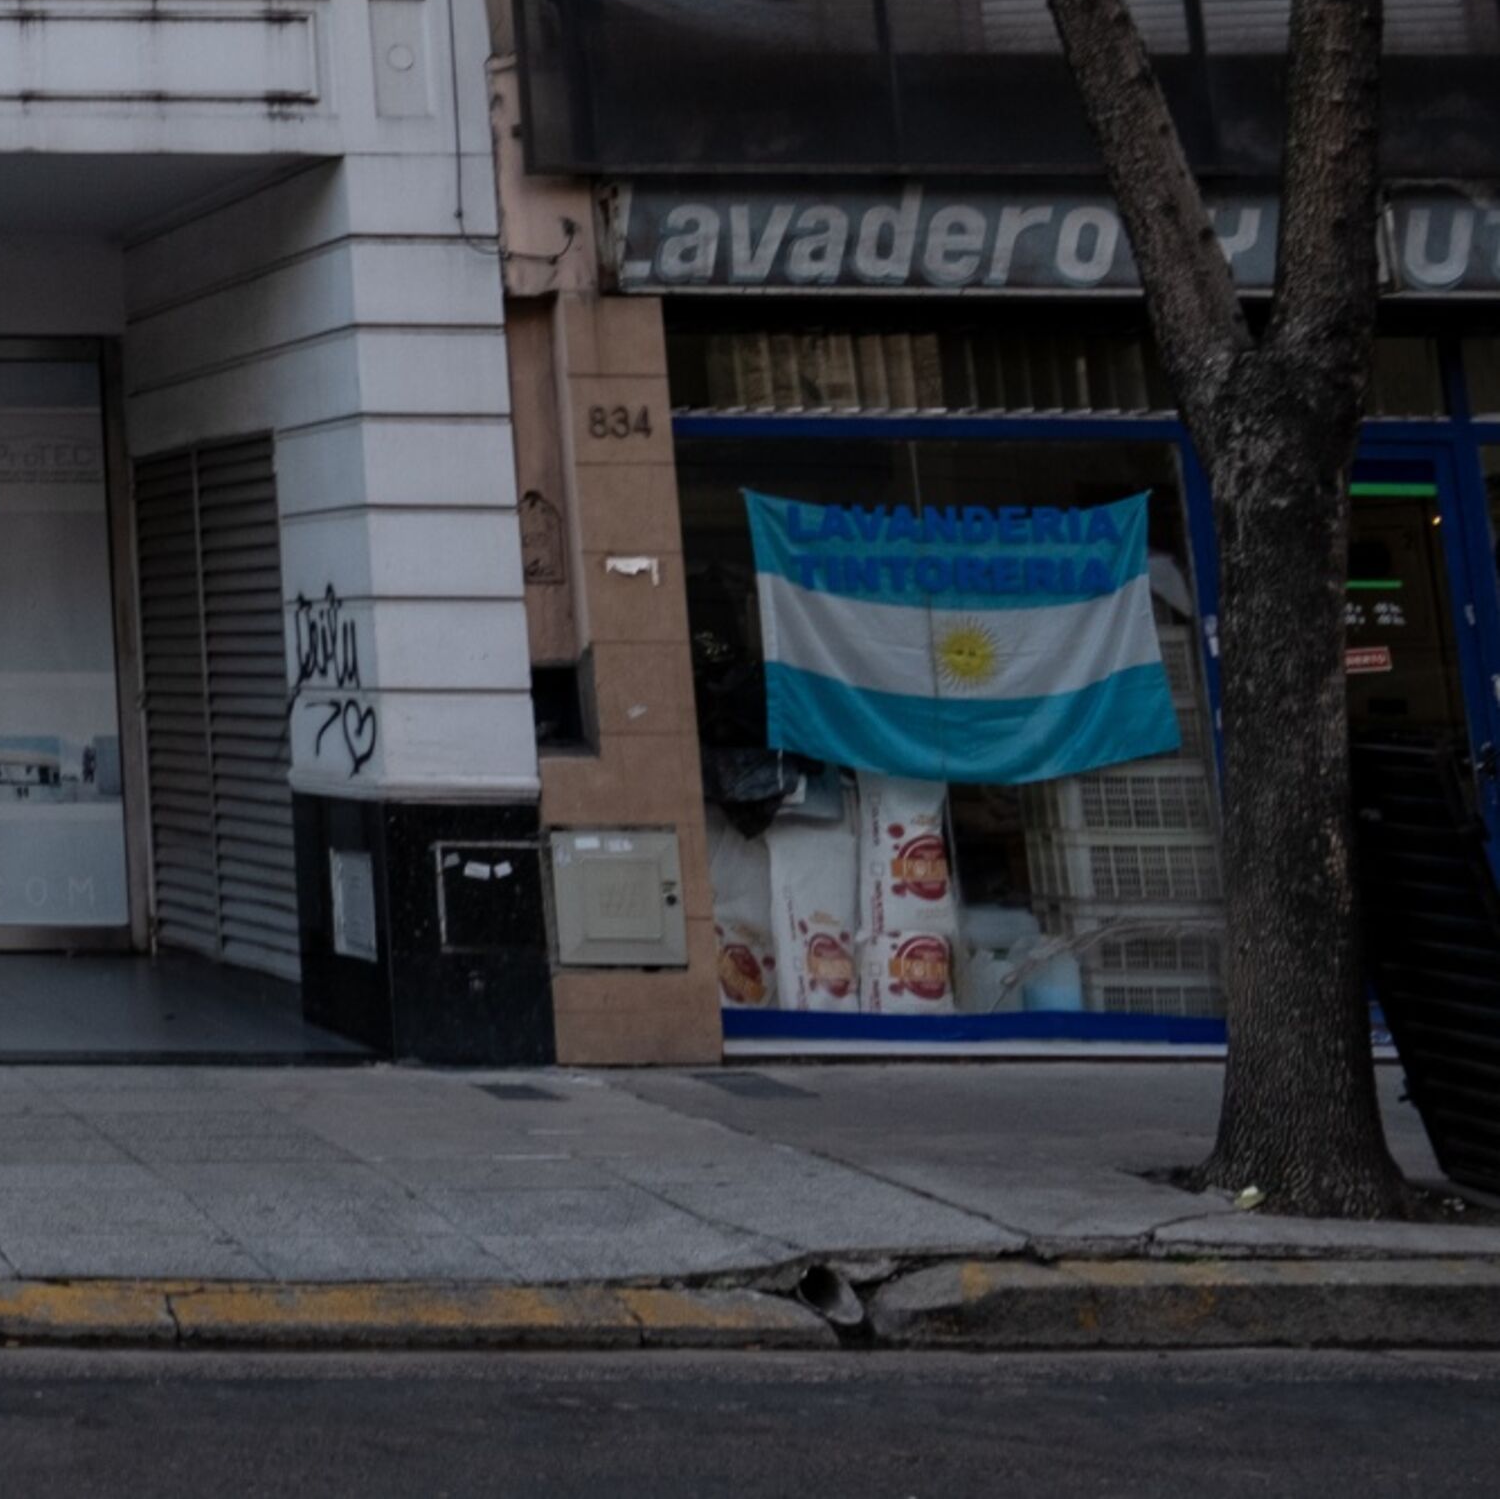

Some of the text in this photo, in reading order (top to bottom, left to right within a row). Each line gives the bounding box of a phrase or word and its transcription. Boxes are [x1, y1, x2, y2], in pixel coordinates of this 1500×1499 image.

[588, 405, 654, 440] 834
[786, 503, 1120, 545] LAVANDERIA
[790, 554, 1117, 594] TINTORERIA
